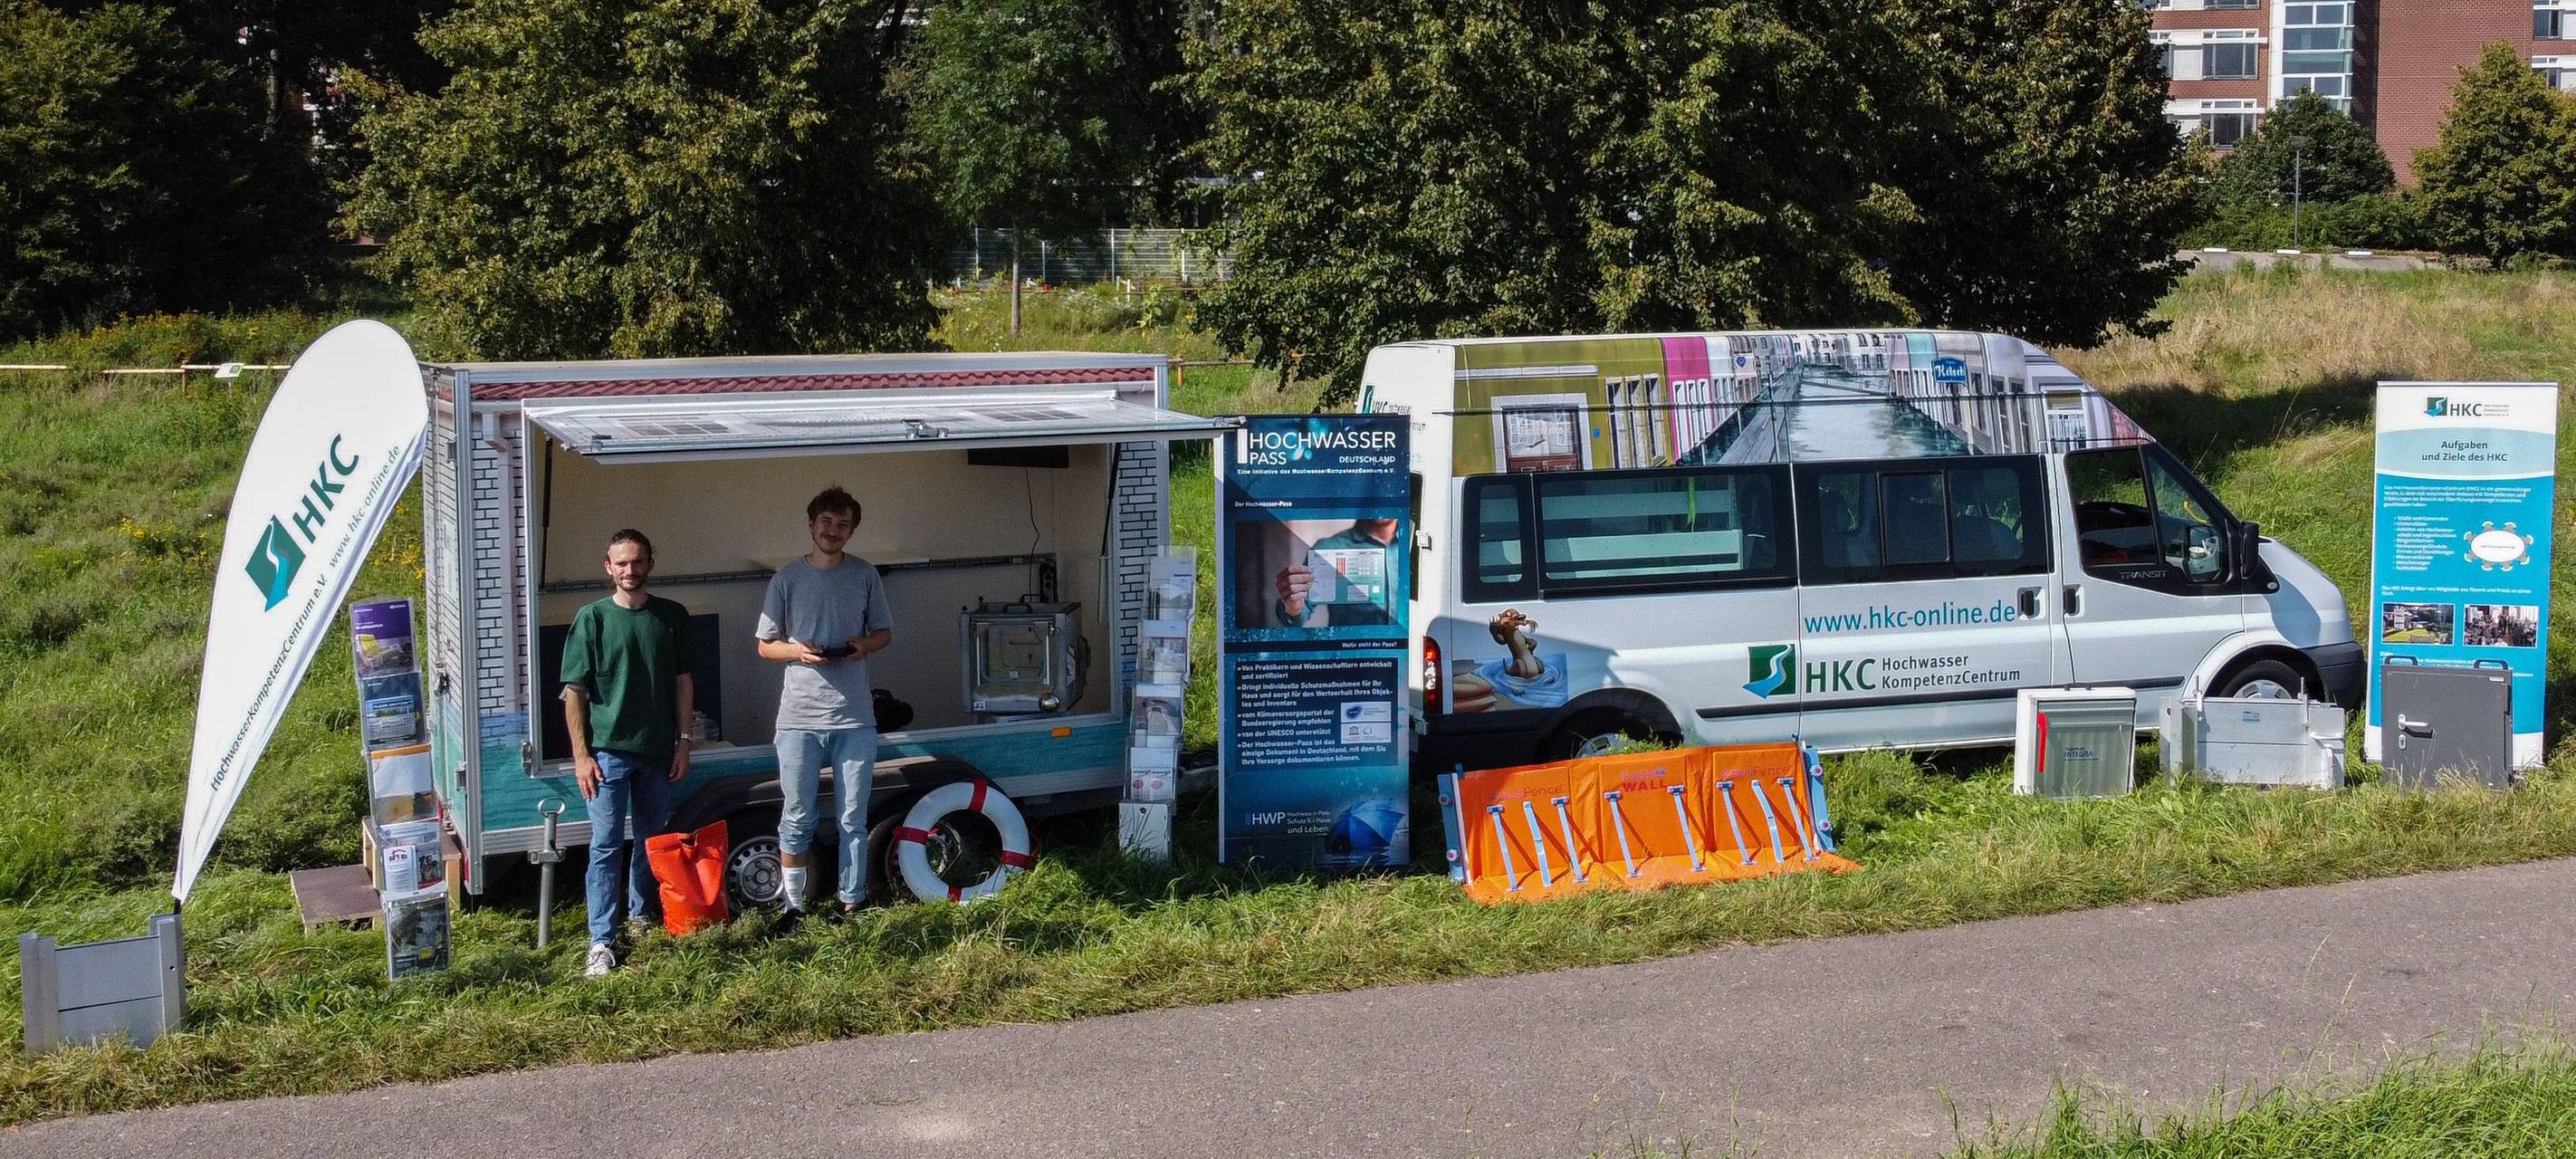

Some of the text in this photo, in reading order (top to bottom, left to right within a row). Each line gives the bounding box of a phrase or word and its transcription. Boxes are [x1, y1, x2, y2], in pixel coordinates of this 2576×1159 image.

[2450, 403, 2483, 417] HKC
[1250, 431, 1396, 449] HOCHWASSER
[2441, 440, 2488, 451] Aufgaben
[1250, 451, 1287, 465] PASS
[1339, 455, 1395, 464] DEUTSCHLAND
[2421, 453, 2439, 461] und
[2442, 453, 2466, 461] Ziele
[2467, 453, 2485, 461] des
[292, 433, 359, 544] HKC
[329, 445, 400, 569] www.hkc-online.de
[2119, 570, 2168, 580] TRANSIT
[1804, 599, 2016, 633] www.hkc-online.de
[1303, 662, 1358, 670] Wissenschaftlern
[1882, 654, 1968, 671] Hochwasser
[1805, 658, 1876, 694] HKC
[1882, 667, 2021, 690] KompetenzCentrum
[1300, 681, 1360, 689] Schutzmaßnahmen
[210, 598, 315, 792] HochwasserKompetenzCentrum
[1316, 689, 1353, 697] Werteerhalt
[1257, 710, 1323, 718] Klimavorsorgeportal
[1241, 719, 1297, 727] Bundesregierung
[1267, 729, 1295, 737] UNESCO
[1255, 740, 1313, 748] Hochwasser-Pass
[1287, 755, 1334, 763] dokumentieren
[1622, 779, 1667, 792] WALL
[1252, 811, 1286, 825] HWP
[1288, 826, 1303, 834] und
